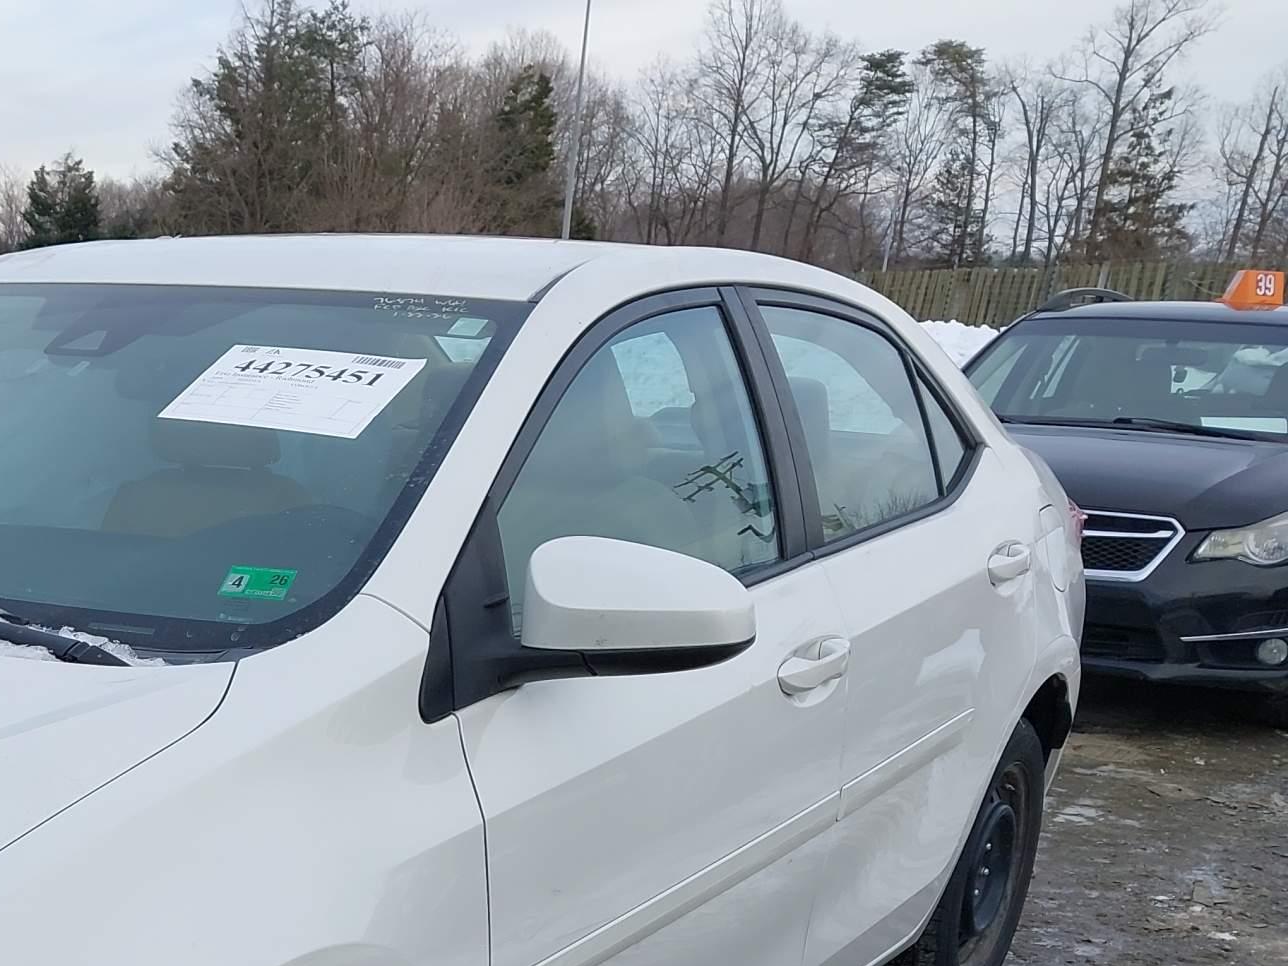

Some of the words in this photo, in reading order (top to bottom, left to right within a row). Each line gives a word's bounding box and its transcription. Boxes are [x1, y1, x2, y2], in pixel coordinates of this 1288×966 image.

[1256, 273, 1275, 296] 39
[234, 358, 385, 387] 44275451
[231, 575, 245, 589] 4
[270, 574, 289, 586] 26
